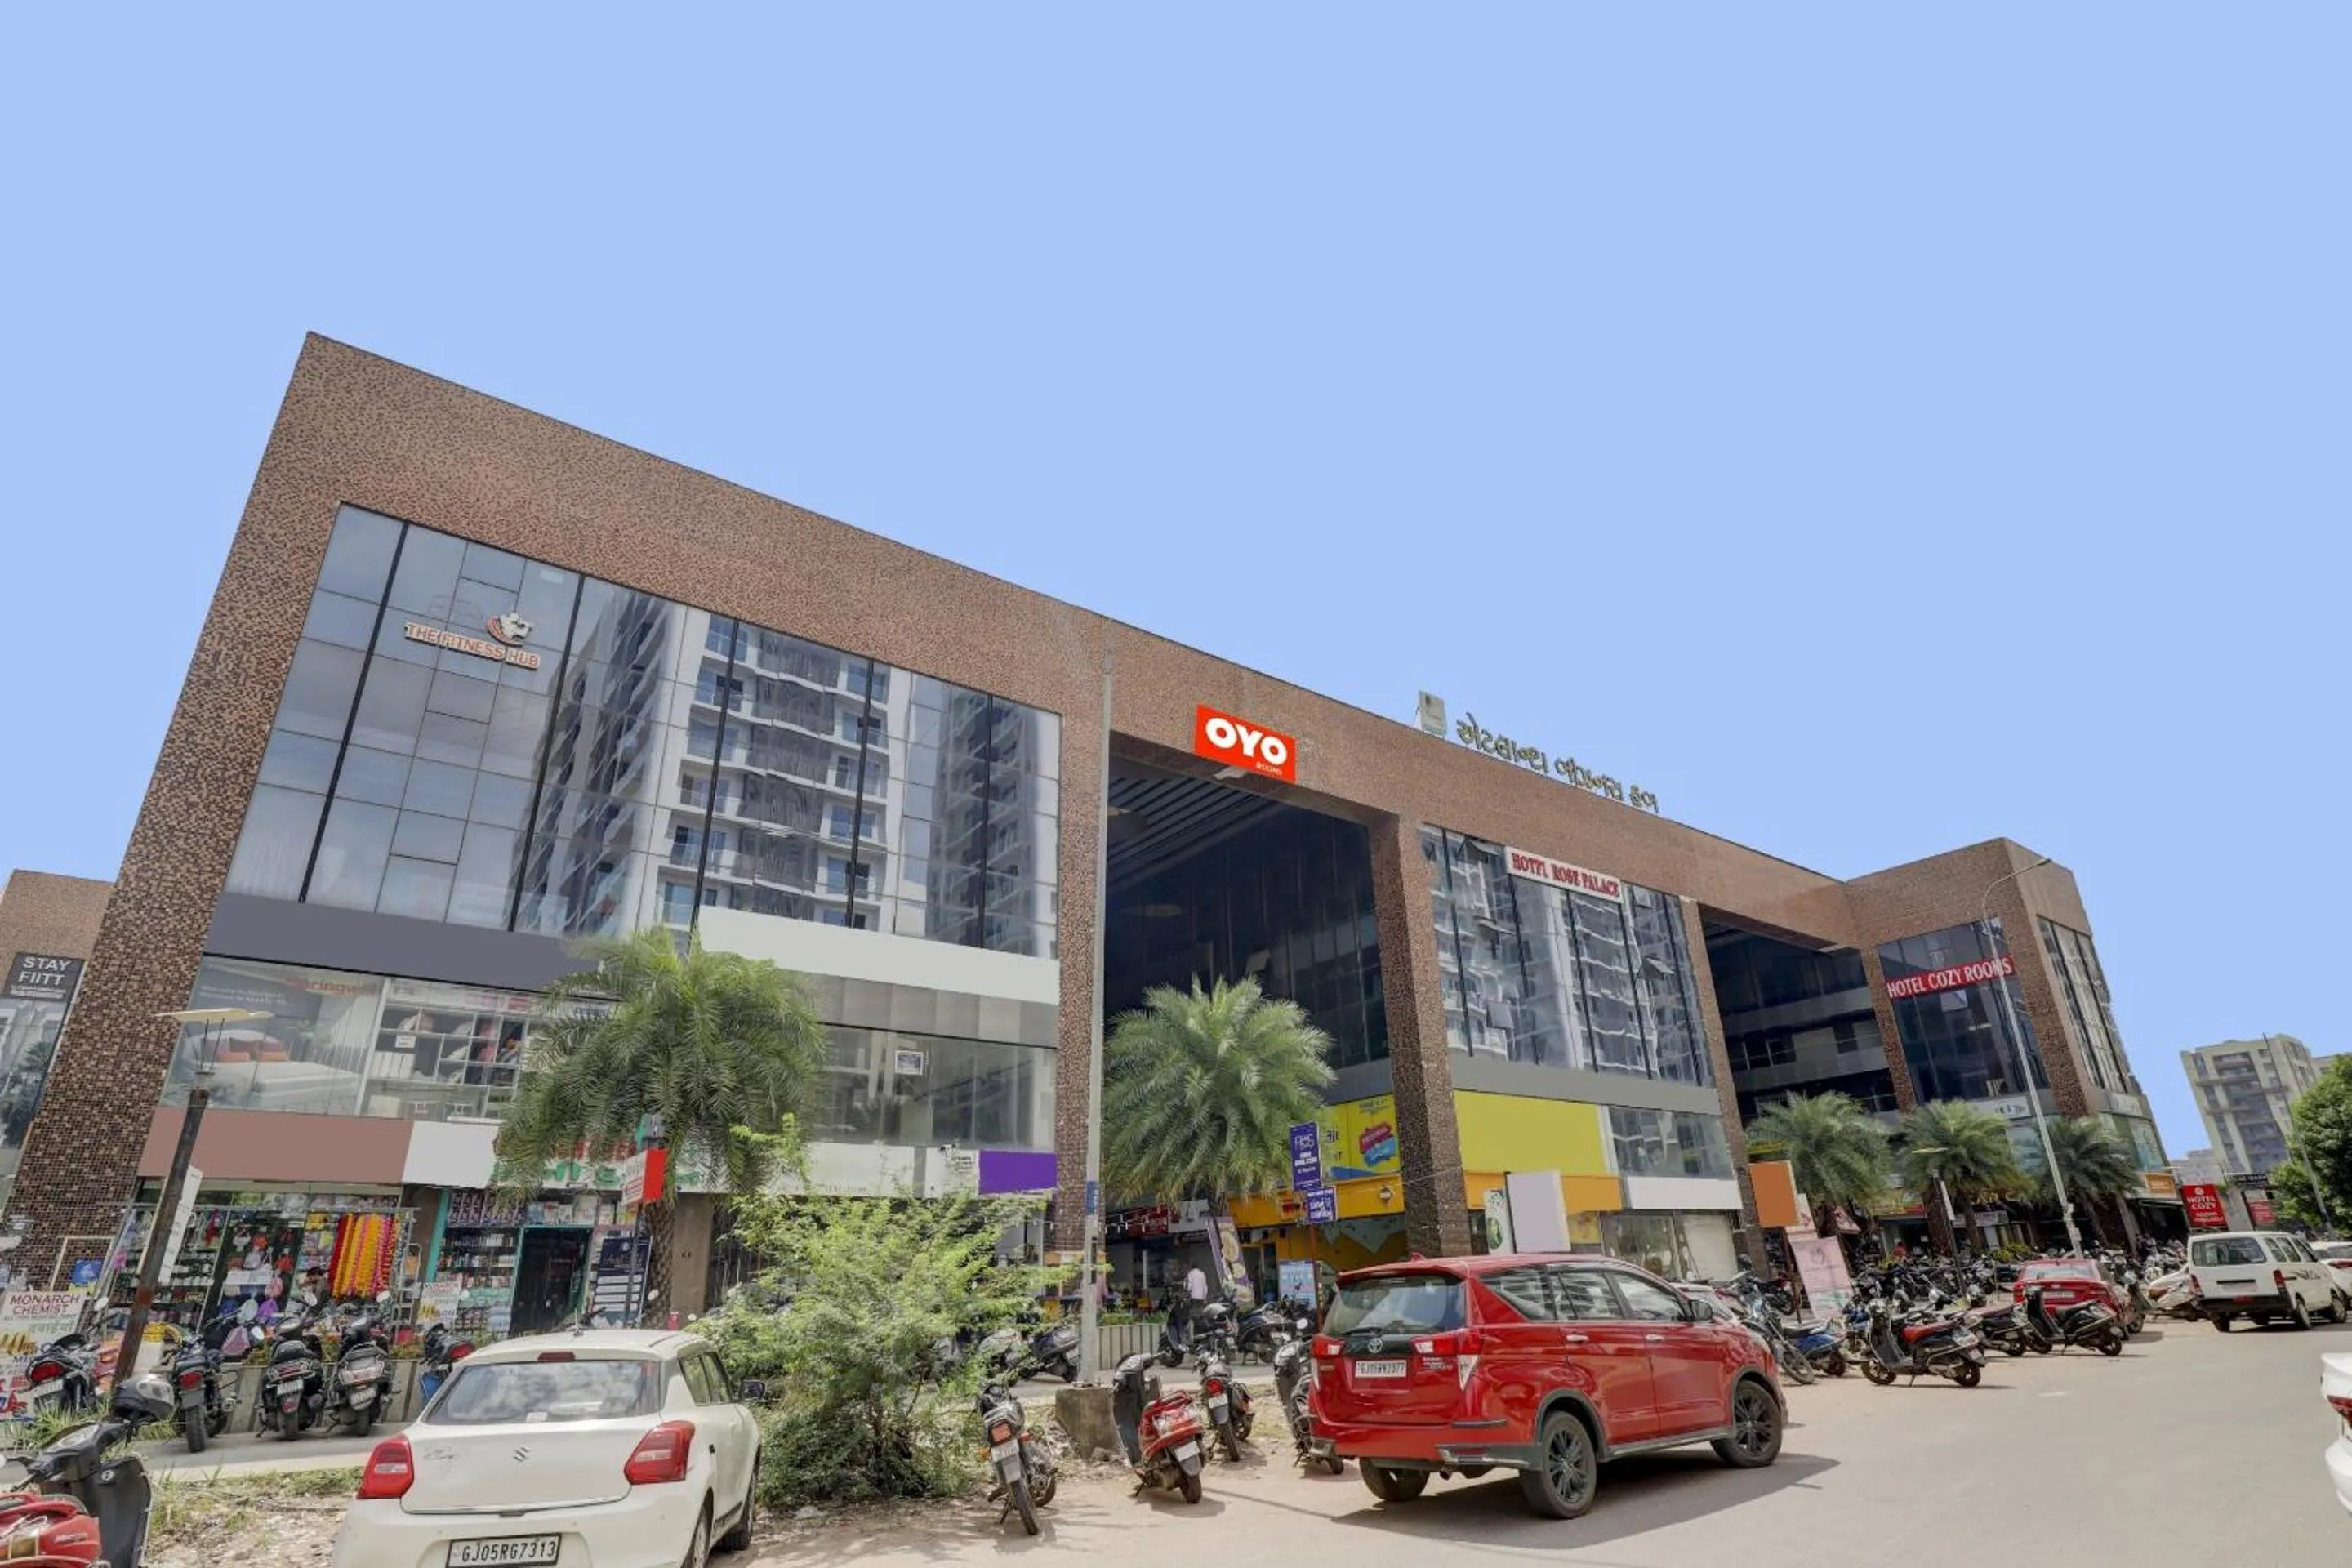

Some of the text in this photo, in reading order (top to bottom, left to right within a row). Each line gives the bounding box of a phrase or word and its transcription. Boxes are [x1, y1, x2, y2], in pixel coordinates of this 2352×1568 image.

[408, 623, 539, 667] THE FITNESS HUB
[1205, 717, 1288, 765] OYO
[1551, 863, 1581, 886] ROSE
[1581, 872, 1620, 898] PALACE
[22, 956, 72, 971] STAY
[18, 971, 65, 986] FIITT
[1886, 976, 1927, 999] HOTEL
[1928, 970, 1962, 990] COZY
[10, 1294, 80, 1305] MONARCH
[12, 1305, 70, 1316] CHEMIST
[461, 1540, 556, 1562] GJ05RG7313
